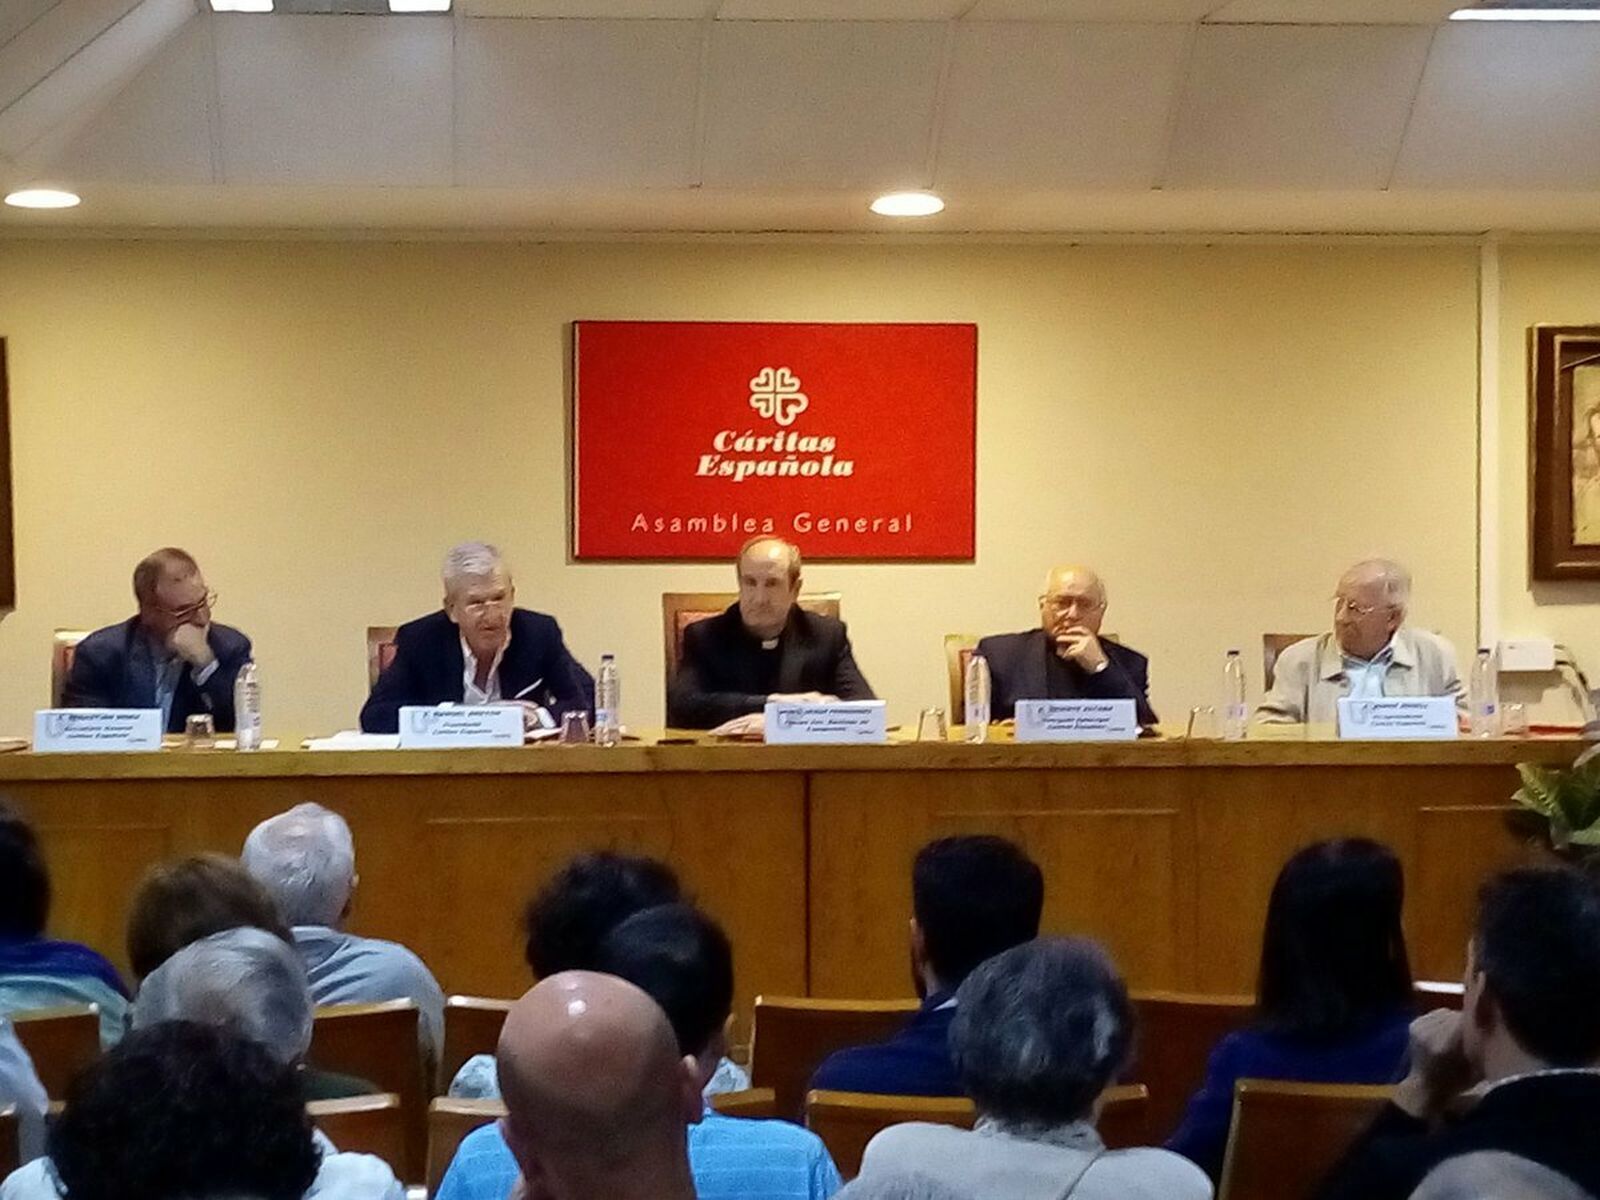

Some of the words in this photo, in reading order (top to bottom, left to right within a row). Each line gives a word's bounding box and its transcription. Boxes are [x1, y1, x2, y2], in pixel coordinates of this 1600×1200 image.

[713, 430, 837, 453] Cáritas
[695, 454, 854, 482] Española
[631, 512, 775, 534] Asamblea
[793, 511, 913, 533] General
